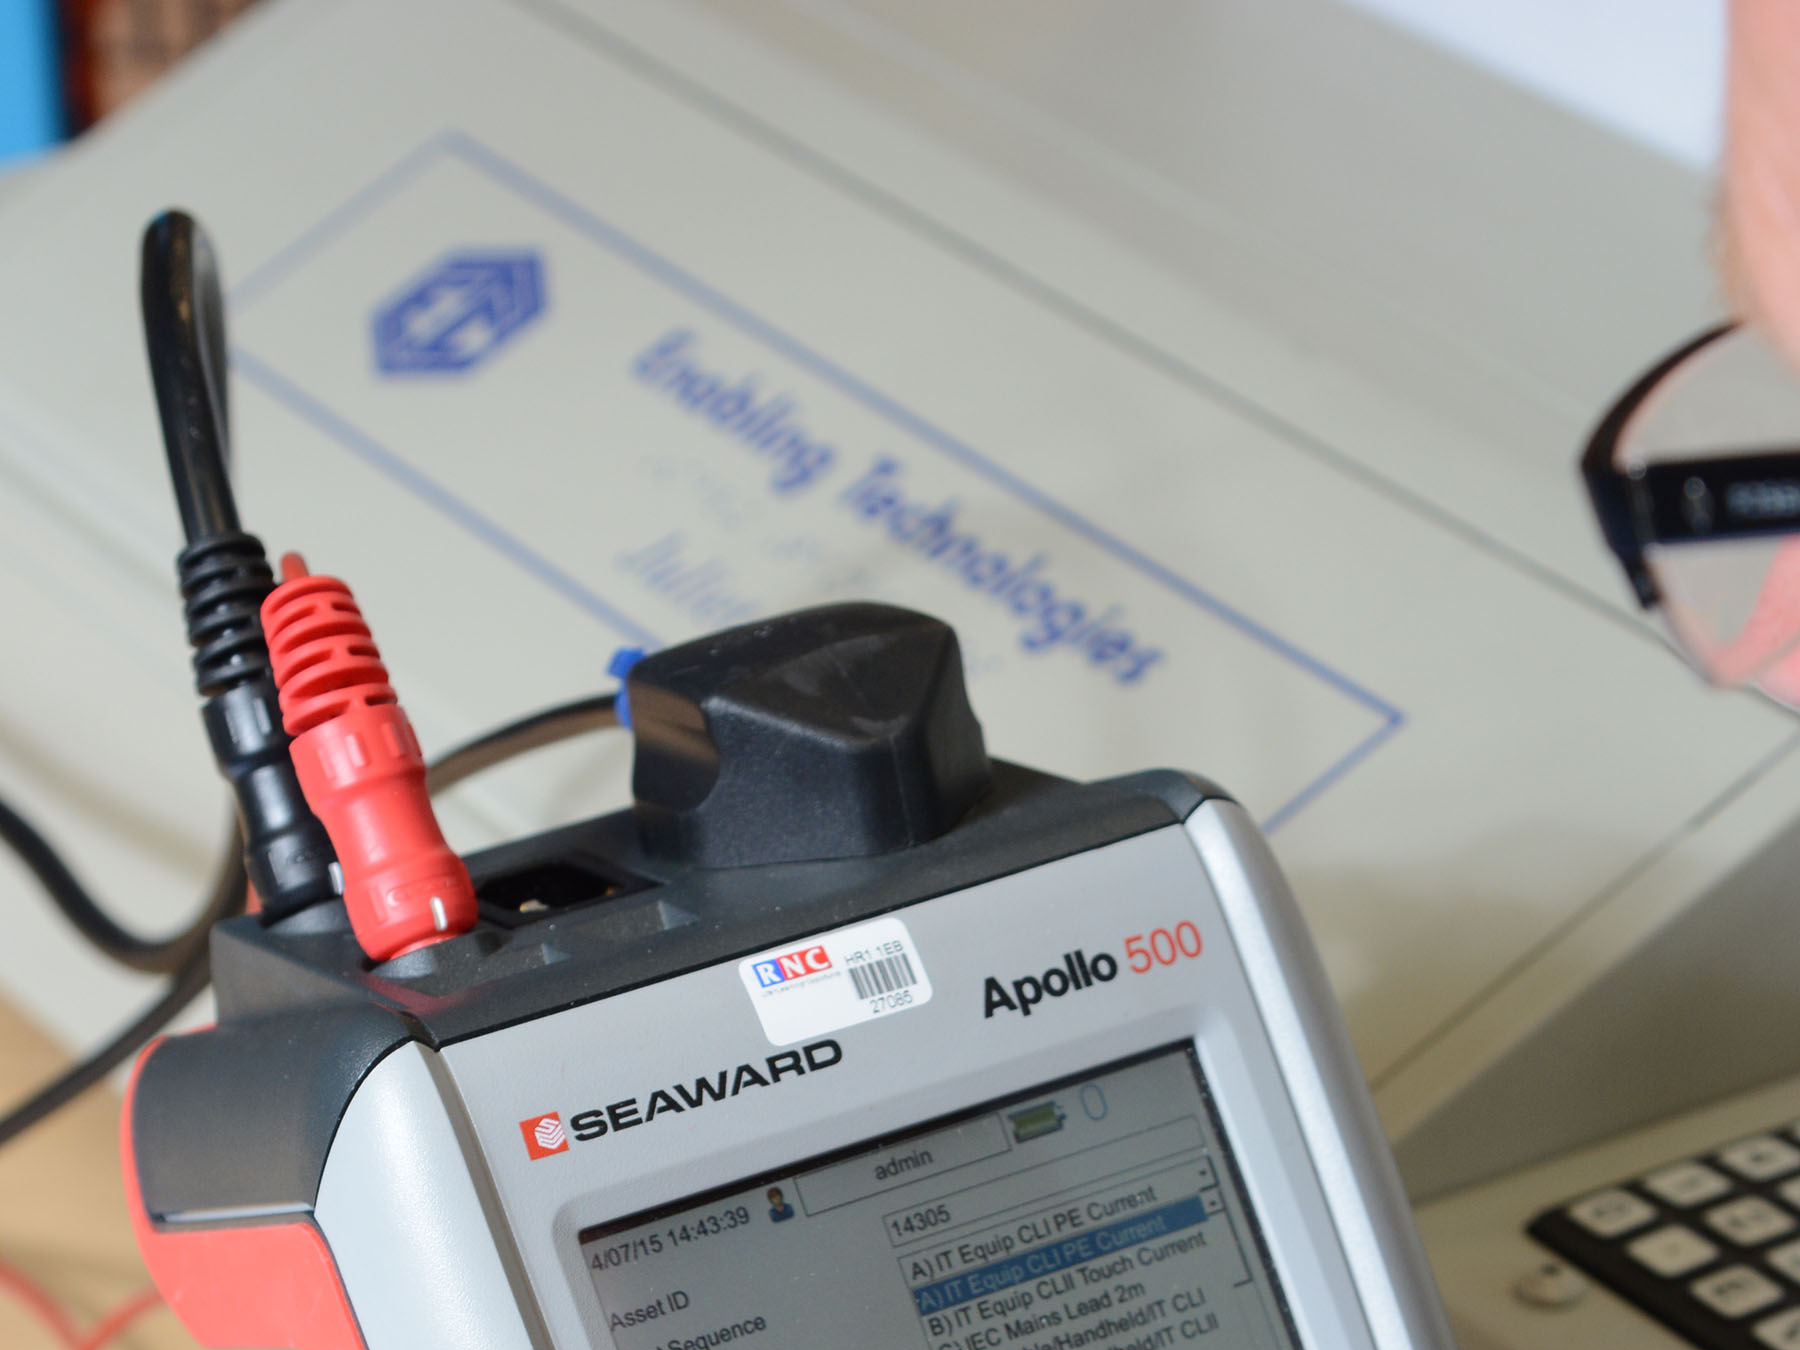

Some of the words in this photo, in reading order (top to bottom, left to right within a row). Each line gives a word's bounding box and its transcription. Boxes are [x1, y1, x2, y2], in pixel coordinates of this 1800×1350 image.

[632, 328, 838, 494] Enabling
[838, 452, 1164, 685] Technologies
[754, 947, 831, 986] RNC
[983, 950, 1118, 1019] Apollo
[1124, 920, 1203, 974] 500
[569, 1038, 843, 1142] SEAWARD
[875, 1151, 933, 1180] admin
[667, 1206, 750, 1246] 14:43:39
[891, 1204, 951, 1236] 14305
[912, 1259, 934, 1280] A)
[934, 1251, 952, 1271] IT
[958, 1234, 1015, 1263] Equip
[1017, 1218, 1052, 1243] CLI
[1053, 1208, 1083, 1231] PE
[1087, 1185, 1157, 1220] Current
[920, 1288, 944, 1311] A)
[945, 1280, 963, 1299] IT
[968, 1265, 1024, 1293] Equip
[1026, 1251, 1060, 1273] CLI
[1063, 1237, 1094, 1259] PE
[1096, 1215, 1166, 1249] Current
[928, 1315, 952, 1336] B)
[955, 1306, 972, 1327] IT
[977, 1291, 1033, 1320] Equip
[1036, 1272, 1076, 1299] CLII
[1077, 1255, 1135, 1285] Touch
[1137, 1232, 1207, 1265] Current
[610, 1299, 666, 1331] Asset
[667, 1290, 690, 1313] ID
[1004, 1313, 1062, 1341] Mains
[1064, 1290, 1113, 1320] Lead
[1114, 1282, 1146, 1303] 2m
[1172, 1287, 1206, 1313] CLI
[1180, 1312, 1219, 1339] CLII
